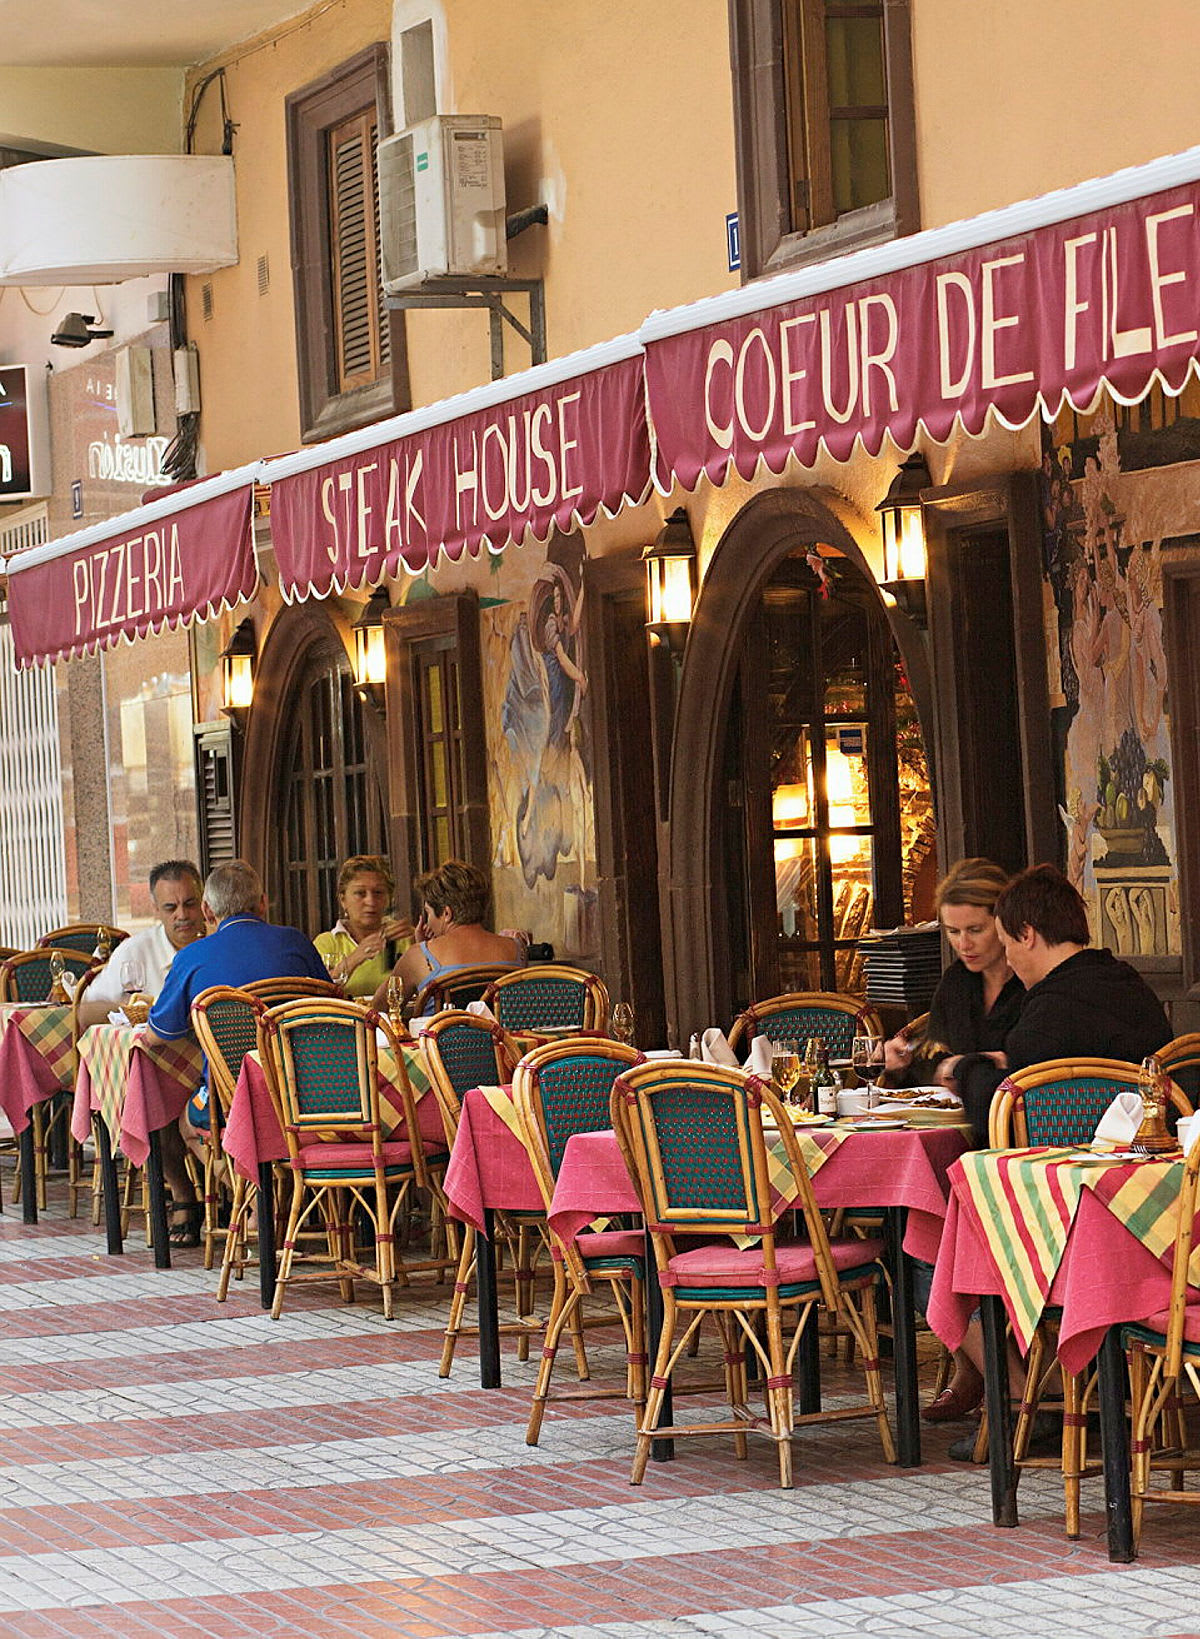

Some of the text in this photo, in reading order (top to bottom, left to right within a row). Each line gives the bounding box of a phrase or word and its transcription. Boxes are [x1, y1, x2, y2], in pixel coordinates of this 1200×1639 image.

[704, 294, 899, 450] COEUR
[937, 255, 1035, 400] DE
[322, 390, 583, 564] STEAK HOUSE
[73, 523, 185, 635] PIZZERIA
